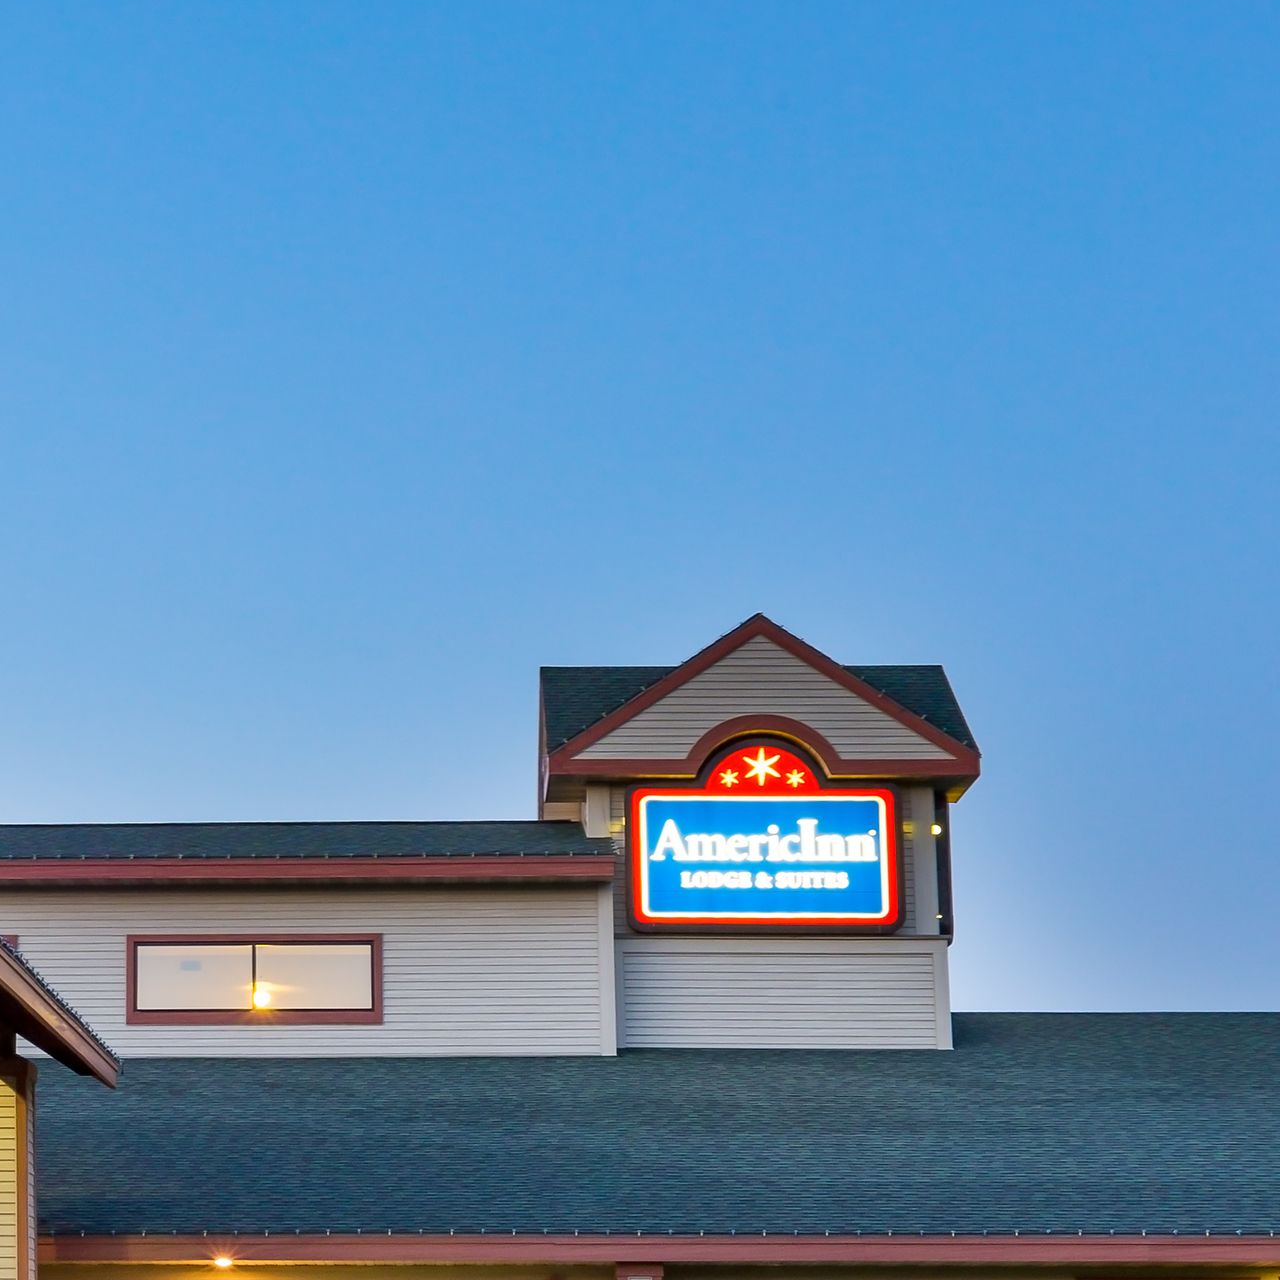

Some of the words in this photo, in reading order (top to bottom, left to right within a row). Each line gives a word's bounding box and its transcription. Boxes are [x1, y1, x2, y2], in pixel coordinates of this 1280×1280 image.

[648, 817, 879, 862] AmericInn
[680, 871, 752, 888] LODGE
[754, 871, 773, 888] &
[775, 871, 849, 888] SUITES
